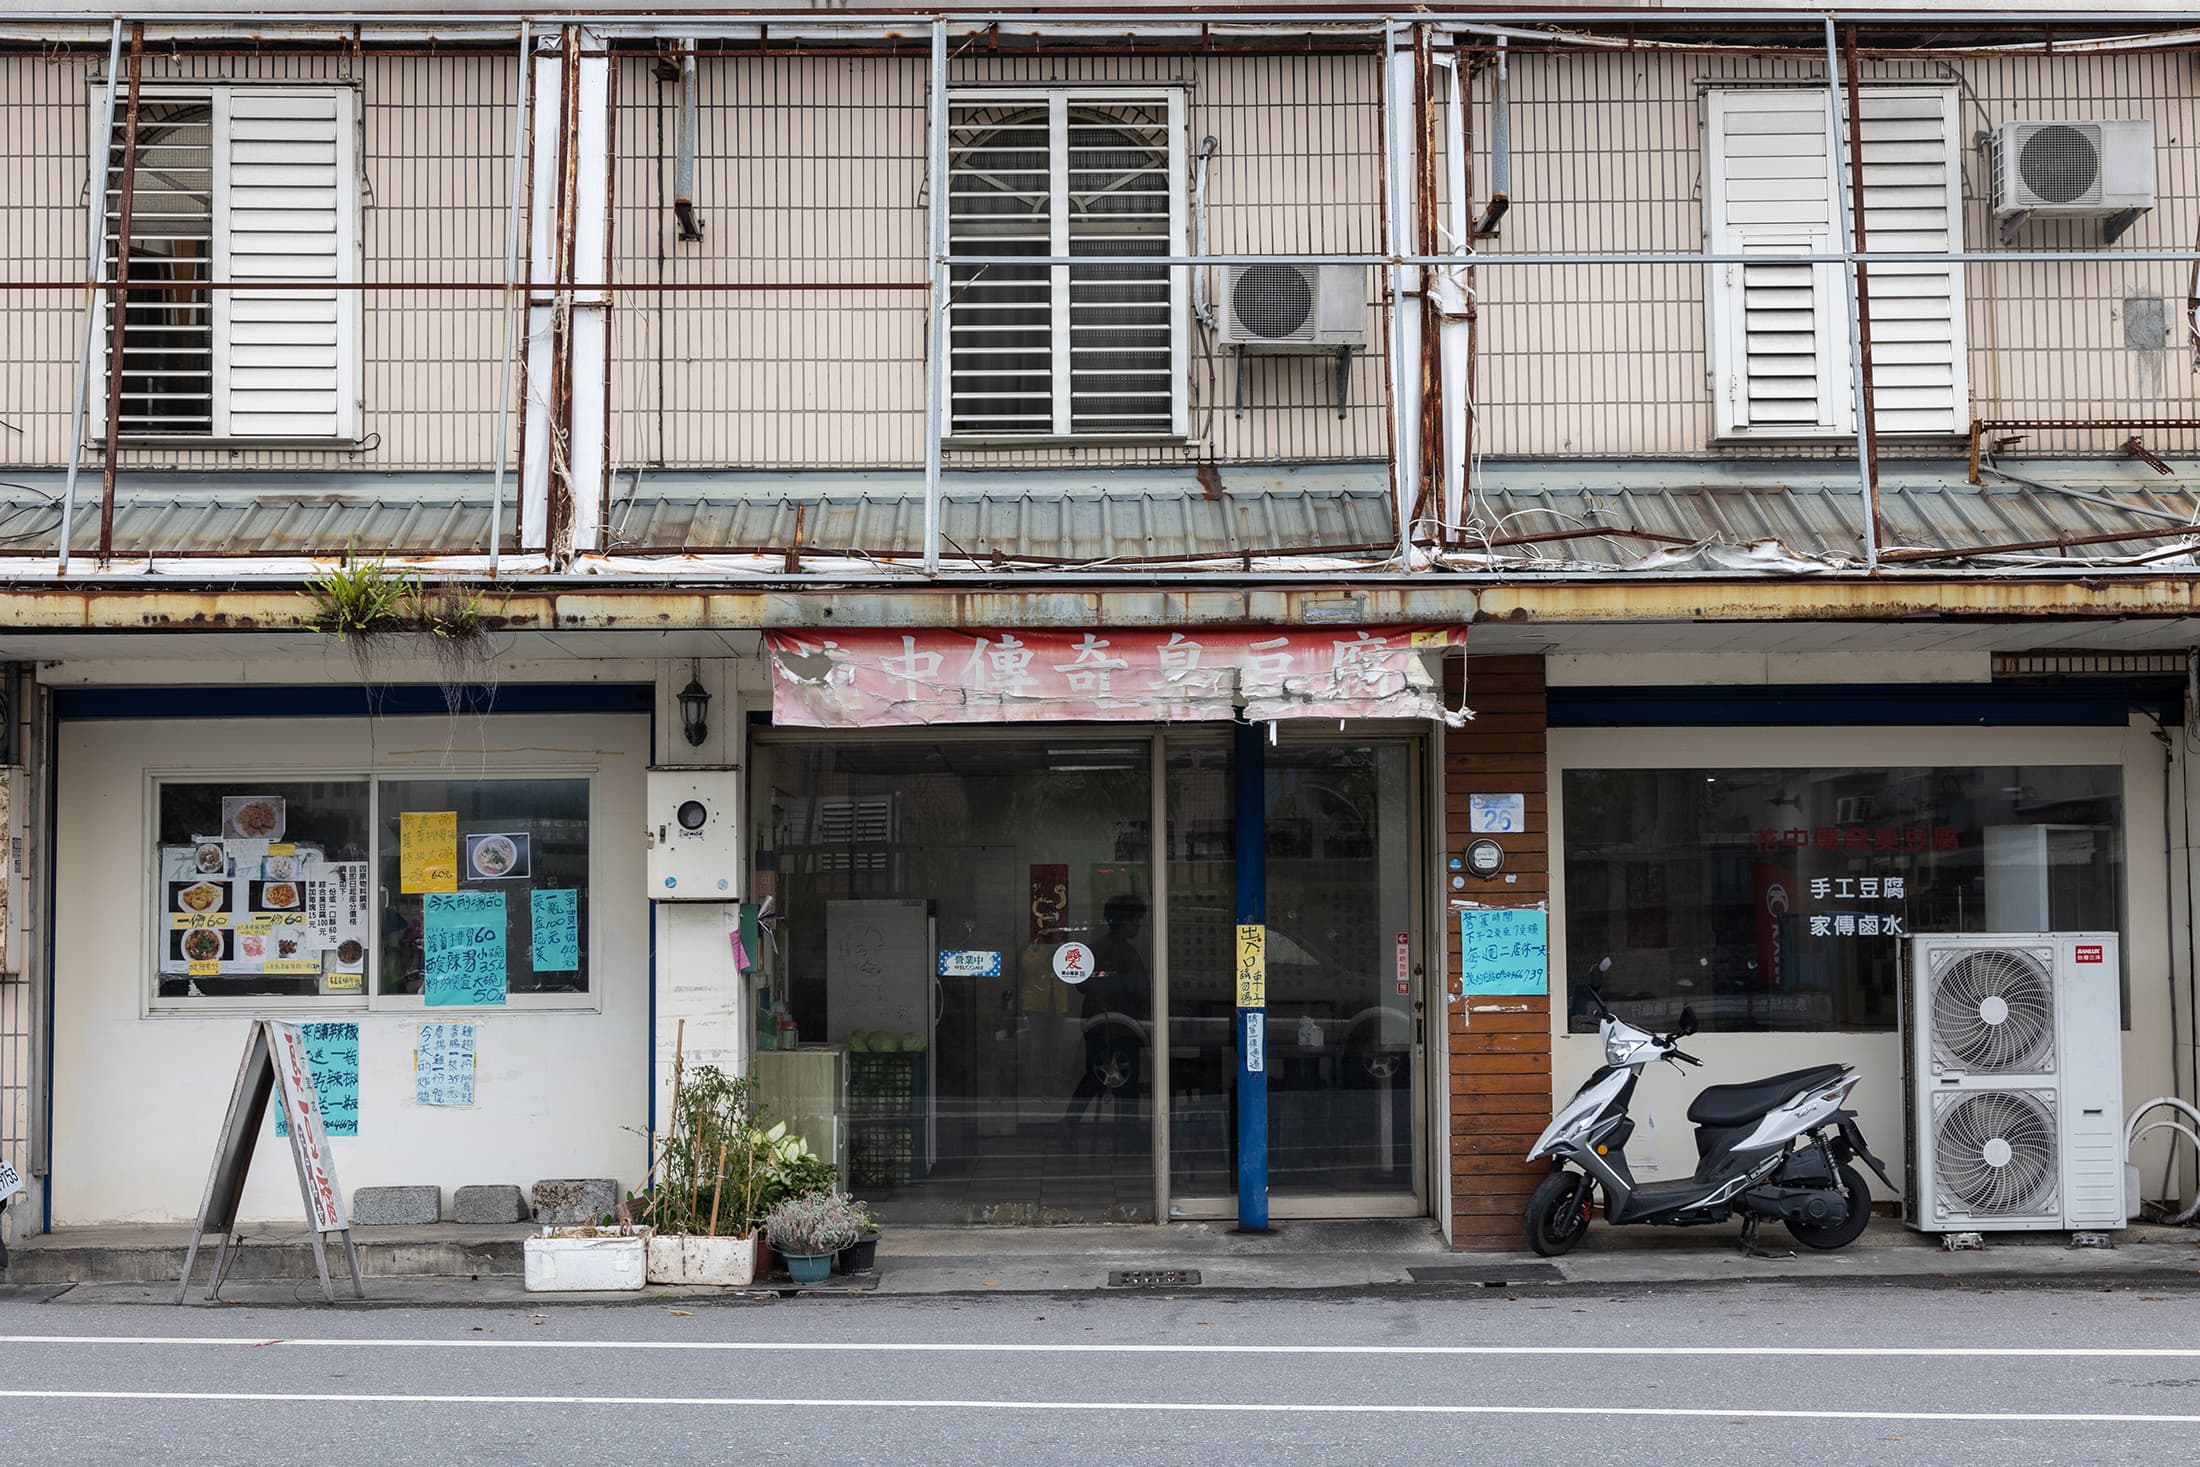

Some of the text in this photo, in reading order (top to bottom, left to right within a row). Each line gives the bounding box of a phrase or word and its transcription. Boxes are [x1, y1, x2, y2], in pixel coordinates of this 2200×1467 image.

[797, 631, 1398, 708] 中傳奇臭豆腐
[1754, 826, 1960, 853] 花中傳奇臭豆腐
[1810, 877, 1905, 899] 手工豆腐
[1809, 914, 1904, 937] 家傳鹵水
[1241, 926, 1260, 968] 出入口
[955, 955, 984, 965] 營業中
[1064, 948, 1083, 970] 愛
